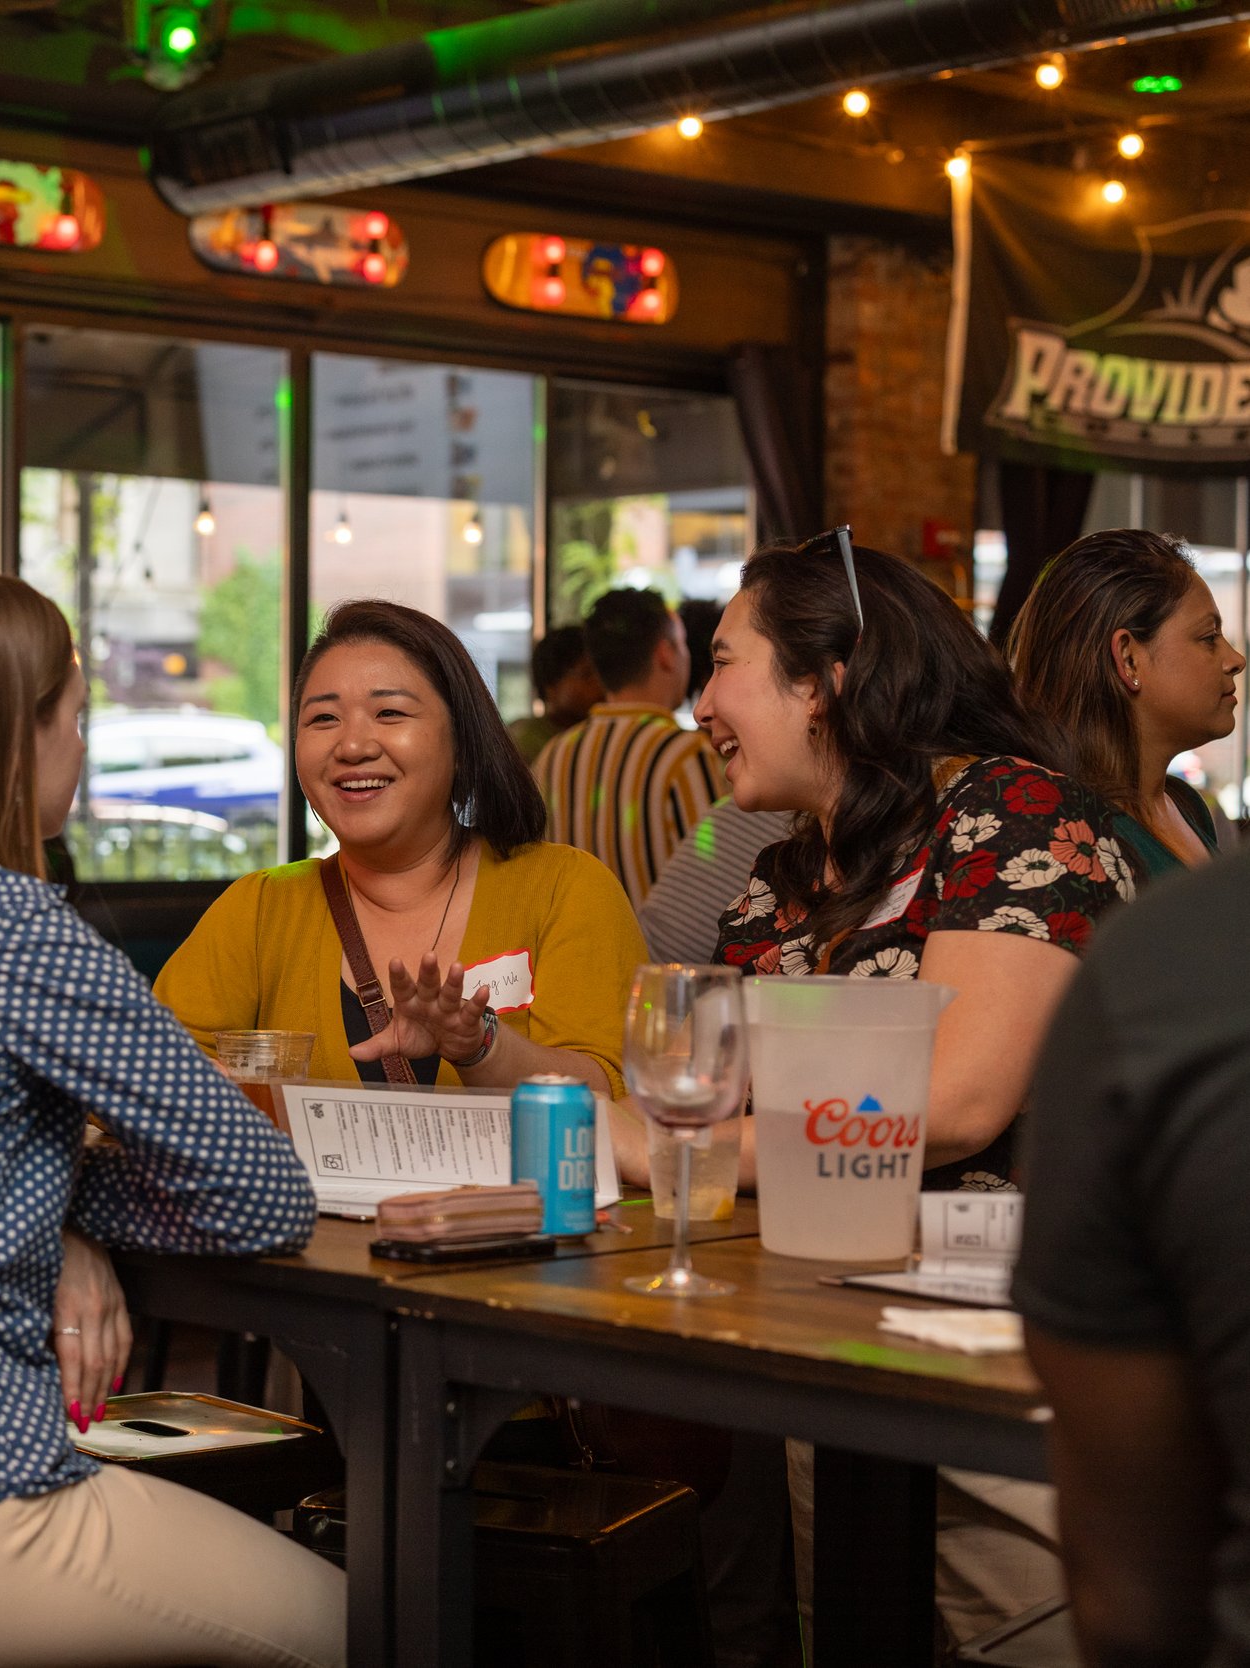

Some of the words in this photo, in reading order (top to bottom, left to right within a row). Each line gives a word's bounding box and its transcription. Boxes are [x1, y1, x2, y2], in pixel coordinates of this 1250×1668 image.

[803, 1098, 921, 1148] Coors
[564, 1127, 594, 1159] LO
[817, 1152, 910, 1180] LIGHT
